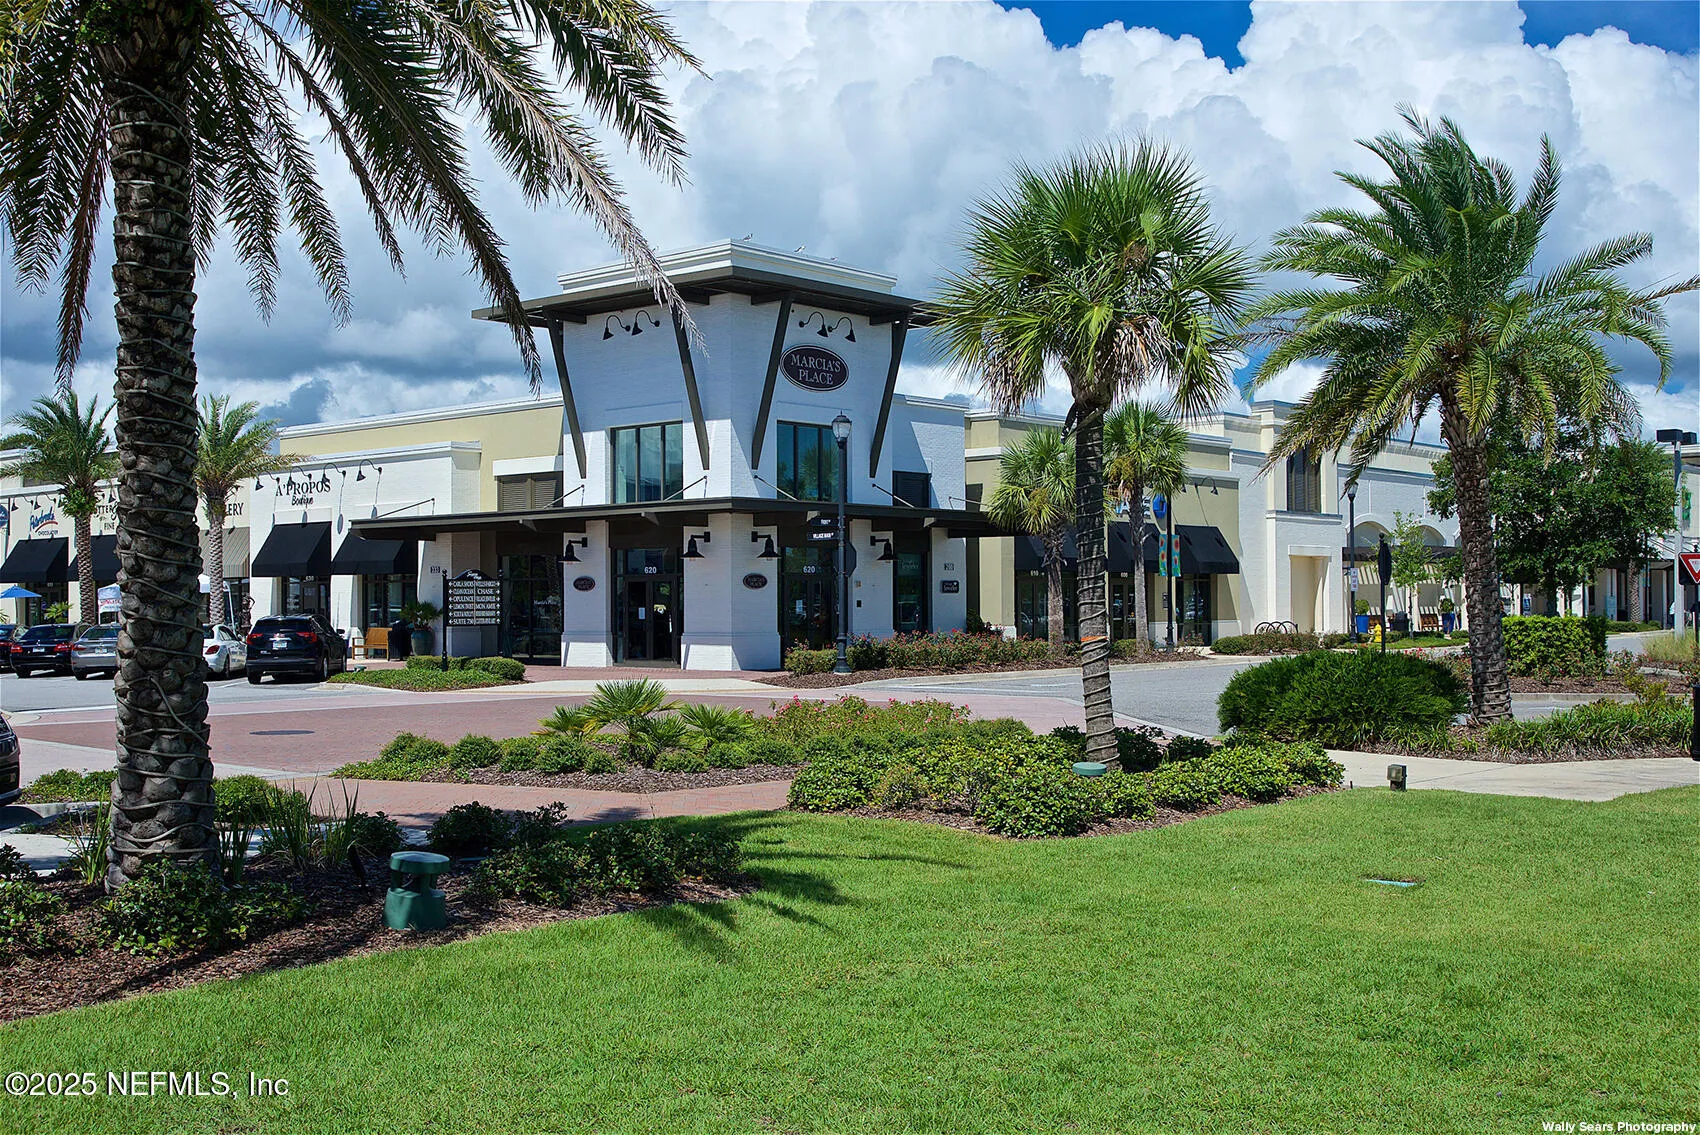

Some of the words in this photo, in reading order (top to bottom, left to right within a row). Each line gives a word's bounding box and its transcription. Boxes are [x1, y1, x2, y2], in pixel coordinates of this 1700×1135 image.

[791, 354, 841, 372] MARCIA'S
[799, 369, 833, 385] PLACE
[644, 566, 657, 574] 620
